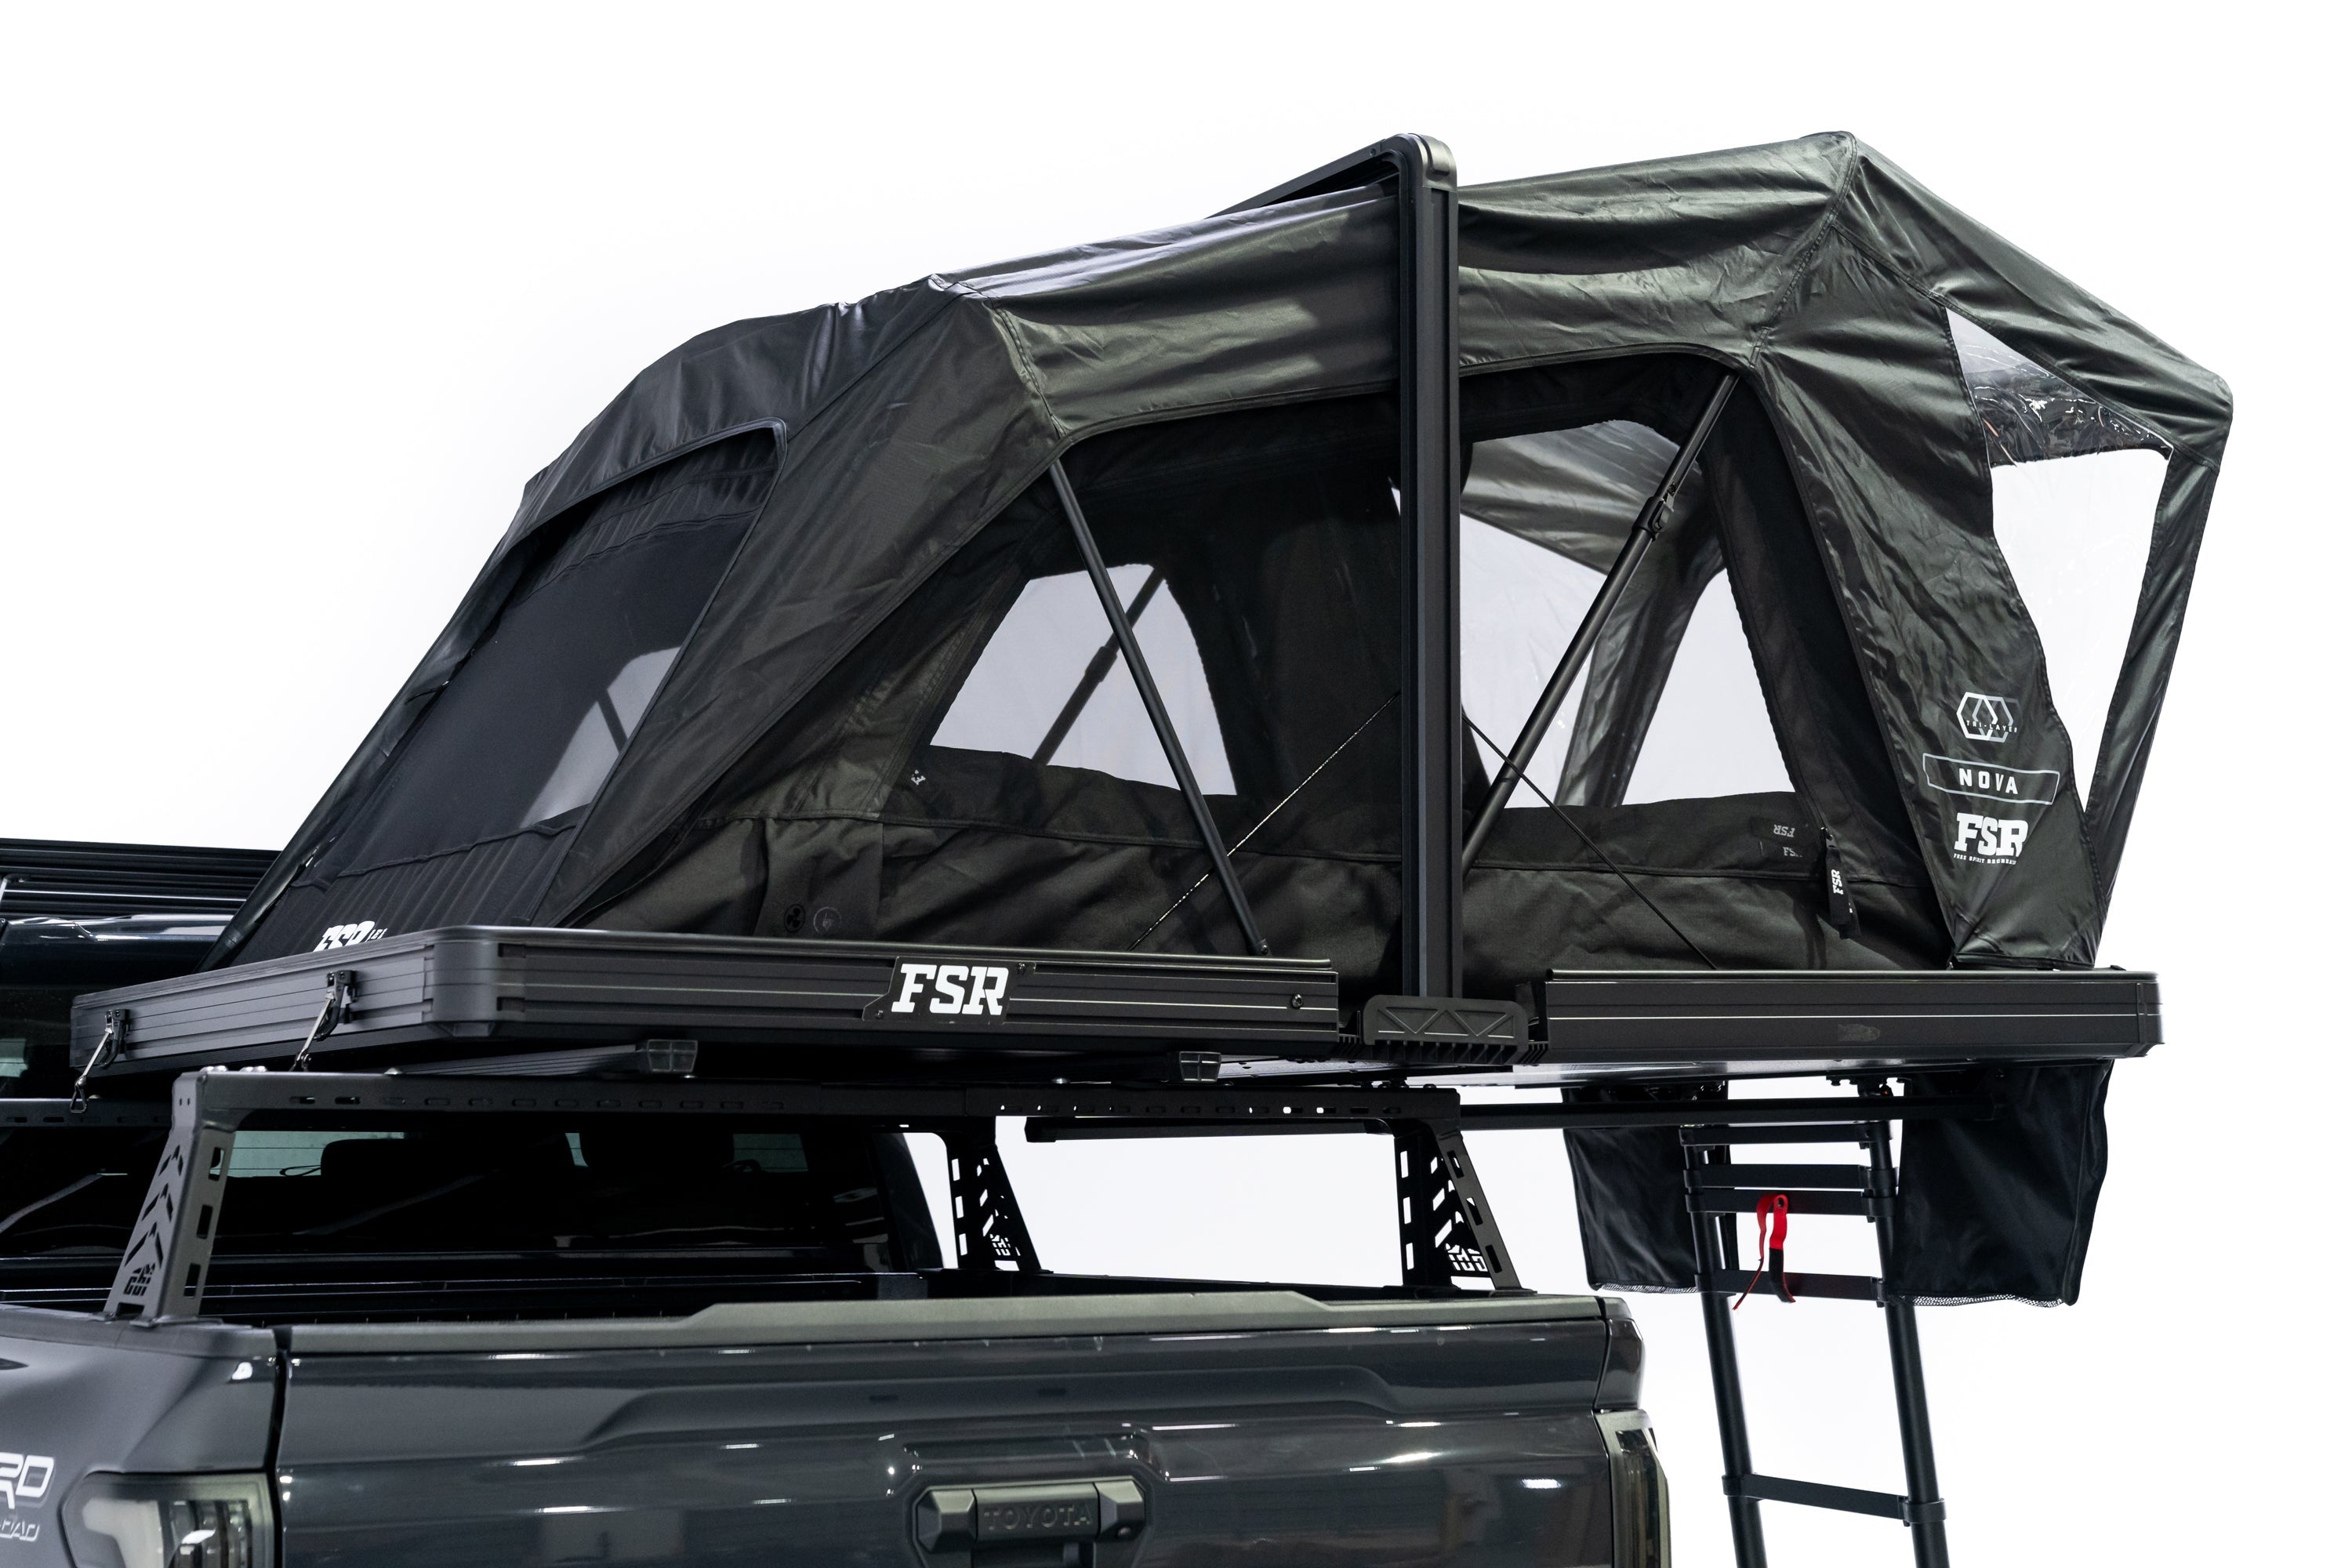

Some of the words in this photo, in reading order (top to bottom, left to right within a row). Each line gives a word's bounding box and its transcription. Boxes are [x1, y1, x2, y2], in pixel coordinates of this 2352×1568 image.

[1965, 720, 2018, 733] TRI-LAYER
[1958, 768, 2019, 795] NOVA
[1773, 823, 1796, 838] FSR
[1953, 811, 2029, 858] FSR
[1782, 846, 1802, 858] FS
[1831, 869, 1844, 895] FSR
[891, 963, 1010, 1016] FSR
[983, 1502, 1094, 1530] TOYOTA
